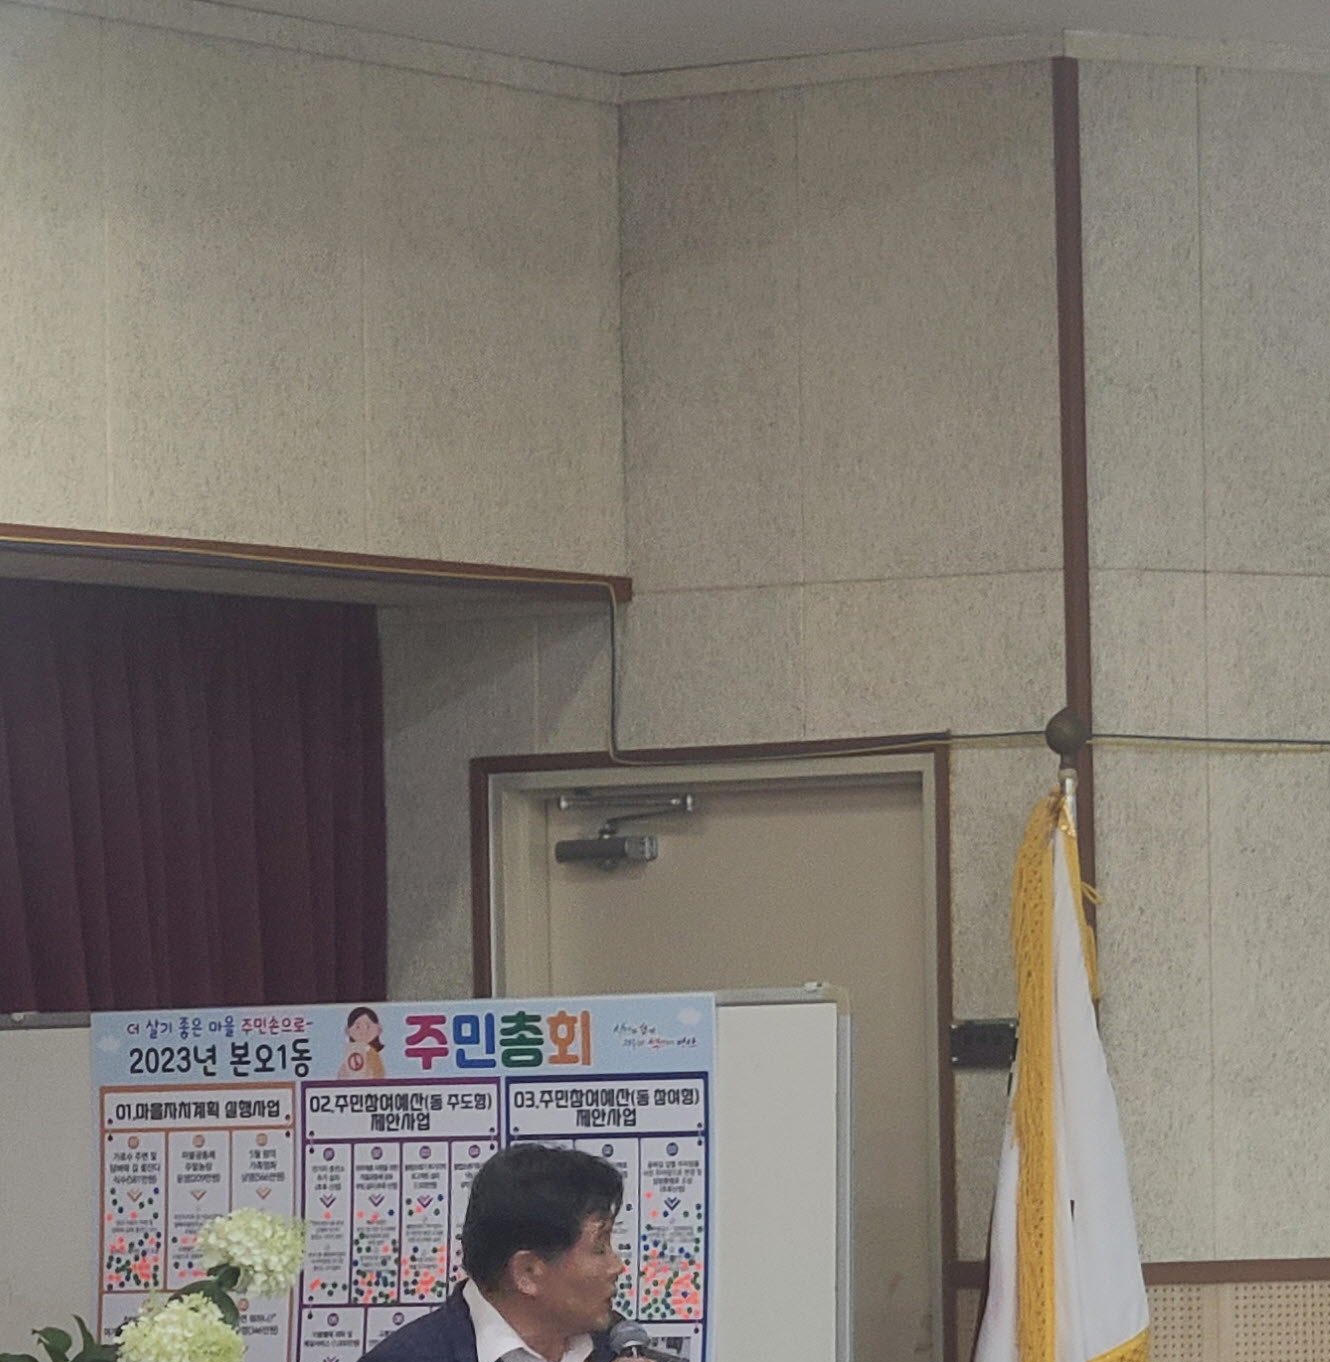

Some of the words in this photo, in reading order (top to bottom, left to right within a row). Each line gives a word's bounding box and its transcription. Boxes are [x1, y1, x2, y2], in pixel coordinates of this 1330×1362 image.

[126, 1022, 140, 1035] 더
[145, 1018, 173, 1040] 살기
[178, 1016, 203, 1041] 좋은
[208, 1015, 235, 1038] 마을
[404, 1009, 592, 1071] 주민총회
[129, 1043, 218, 1078] 2023년
[229, 1037, 313, 1079] 본오1동
[370, 1112, 431, 1132] 제안사업
[575, 1107, 637, 1128] 제안사업
